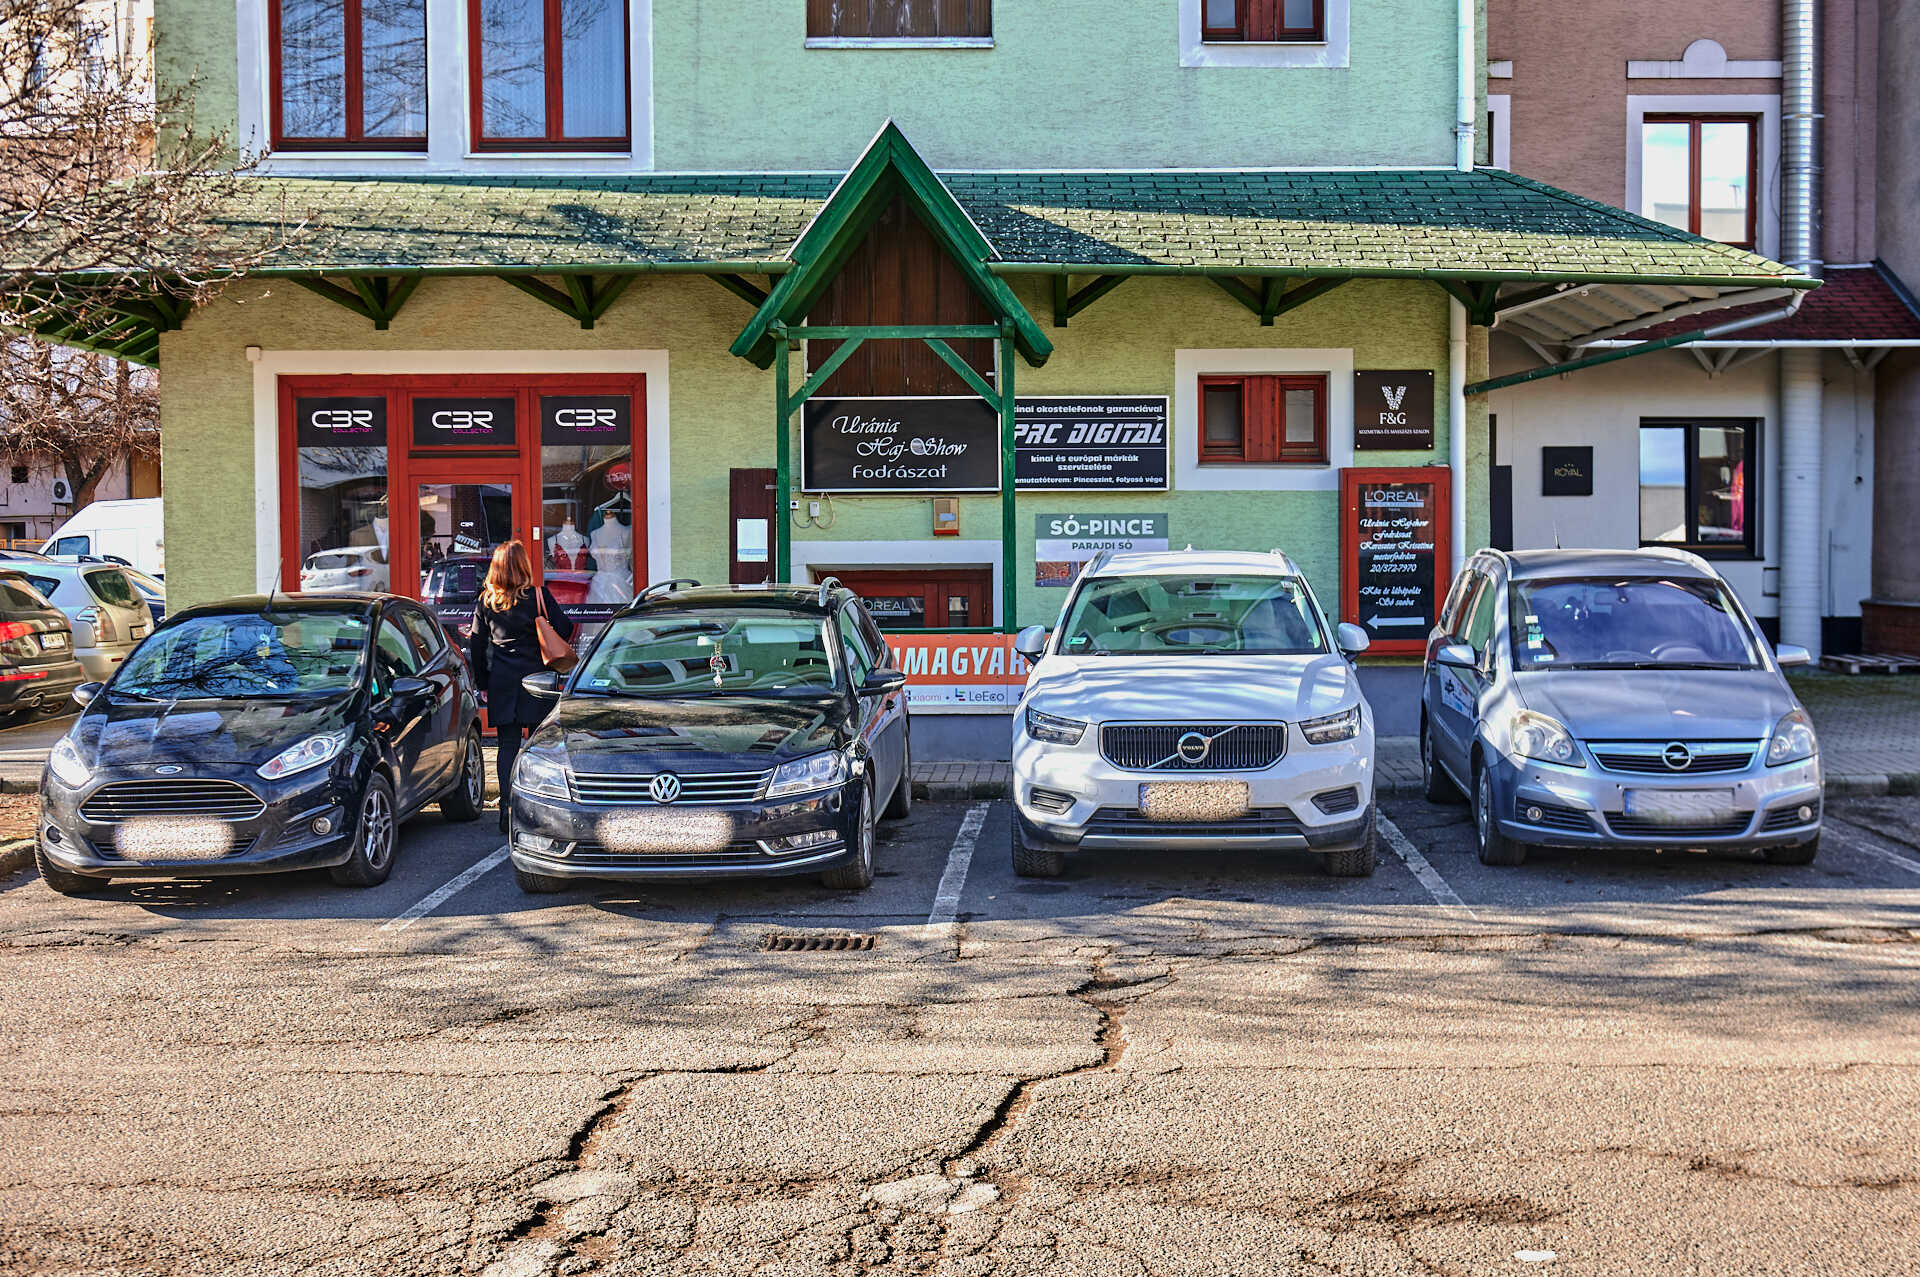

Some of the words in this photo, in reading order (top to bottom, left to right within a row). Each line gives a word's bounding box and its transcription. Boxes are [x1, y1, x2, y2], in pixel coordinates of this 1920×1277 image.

[1036, 405, 1104, 413] okostelefonok
[1106, 404, 1163, 414] garanciával
[832, 415, 901, 434] Uránia
[1379, 412, 1407, 425] F&G
[1066, 423, 1164, 444] DIGITAL
[856, 437, 968, 462] Haj-Show
[1014, 476, 1072, 484] emutatóterem:
[1050, 514, 1155, 536] SÓ-PINCE
[1071, 542, 1115, 550] PARAJDI
[1118, 539, 1133, 550] SÓ
[969, 691, 1005, 702] LeEco
